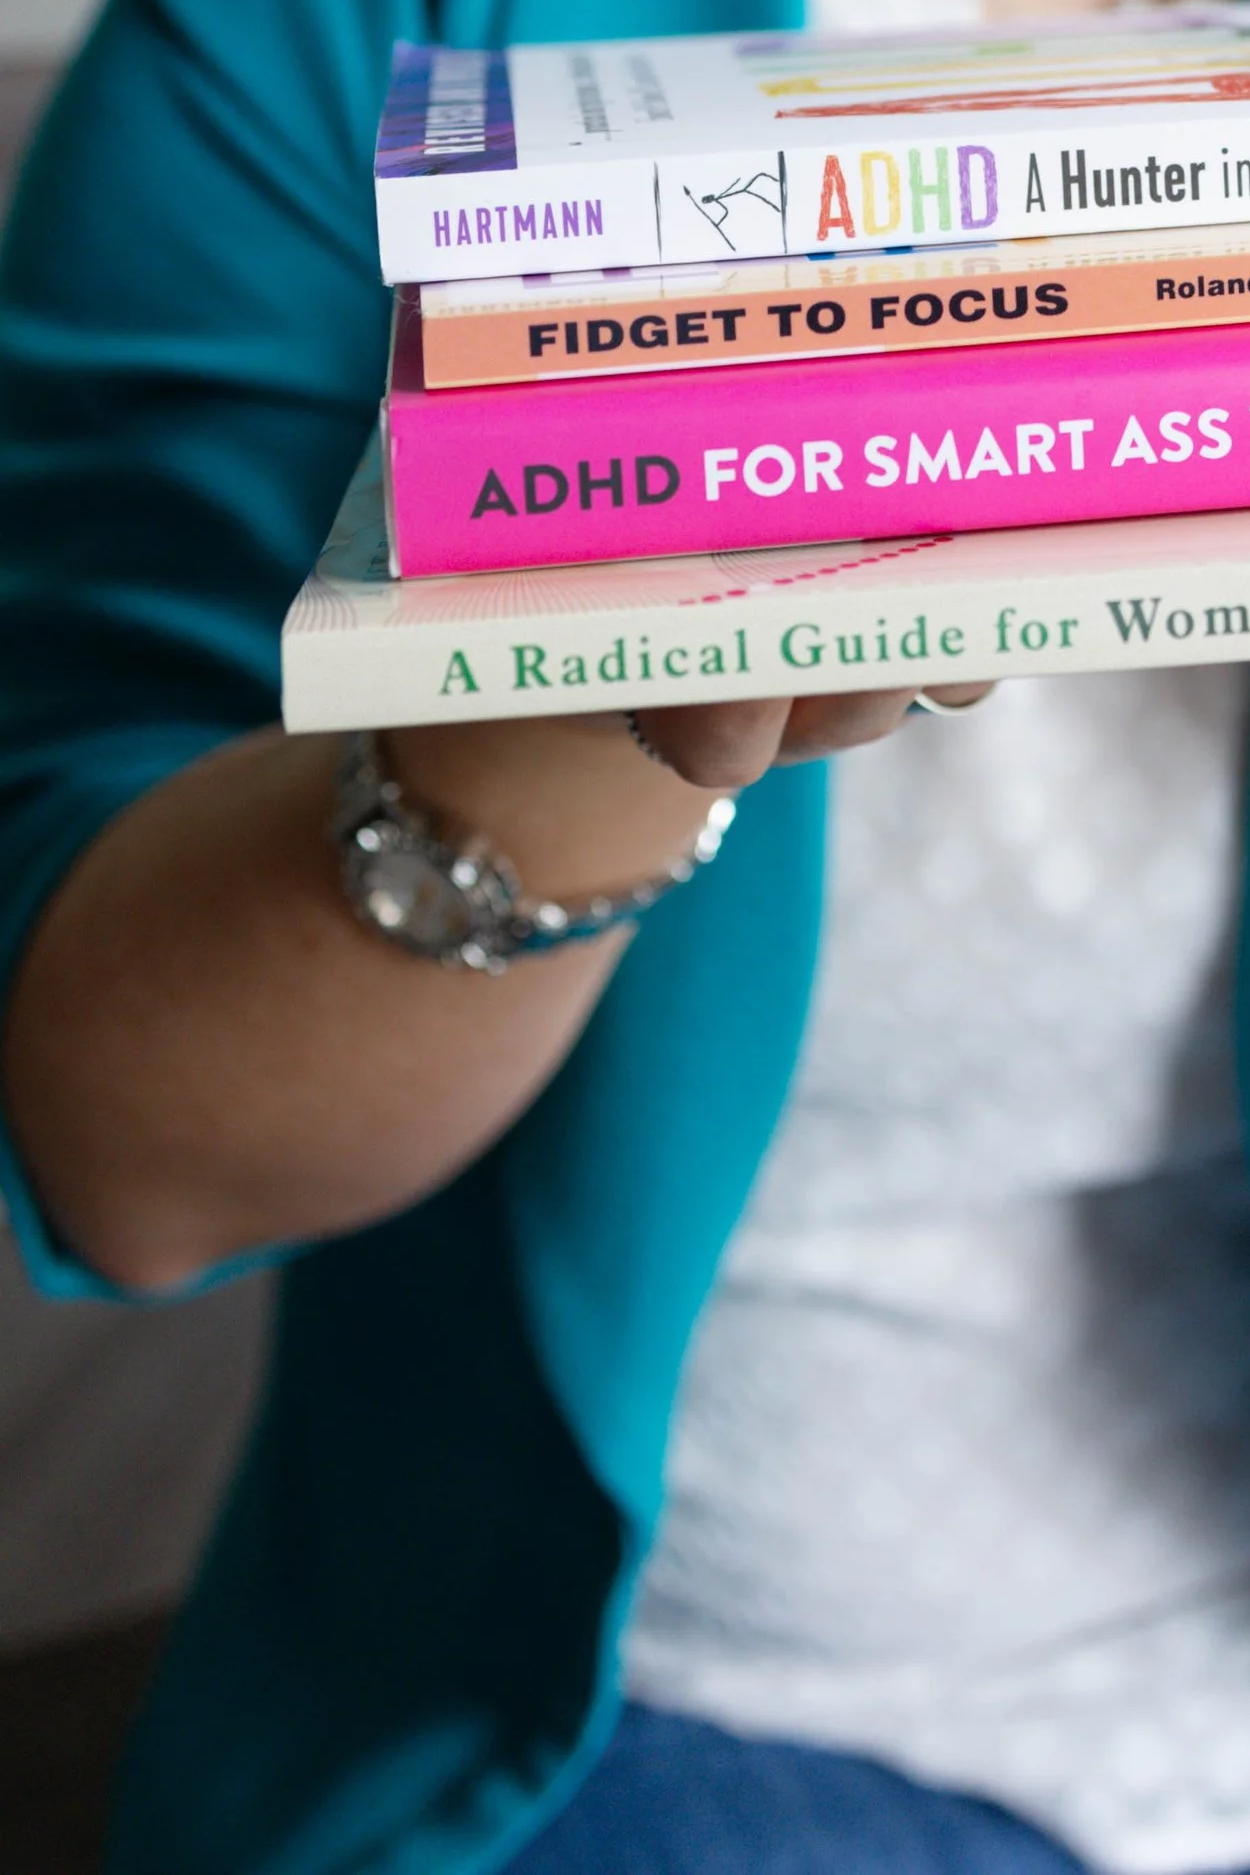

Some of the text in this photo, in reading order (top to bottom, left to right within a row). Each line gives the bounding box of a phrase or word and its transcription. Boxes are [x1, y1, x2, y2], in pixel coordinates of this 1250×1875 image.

[434, 200, 603, 247] HARTMANN
[816, 145, 998, 242] ADHD
[1026, 153, 1046, 213] A
[1061, 150, 1205, 210] Hunter
[528, 283, 1068, 357] FIDGET TO FOCUS
[471, 455, 680, 519] ADHD
[704, 441, 843, 500] FOR
[864, 419, 1093, 487] SMART
[1112, 408, 1232, 466] ASS
[441, 651, 480, 695] A
[512, 630, 749, 690] Radical
[780, 616, 963, 668] Guide
[997, 609, 1078, 652] for
